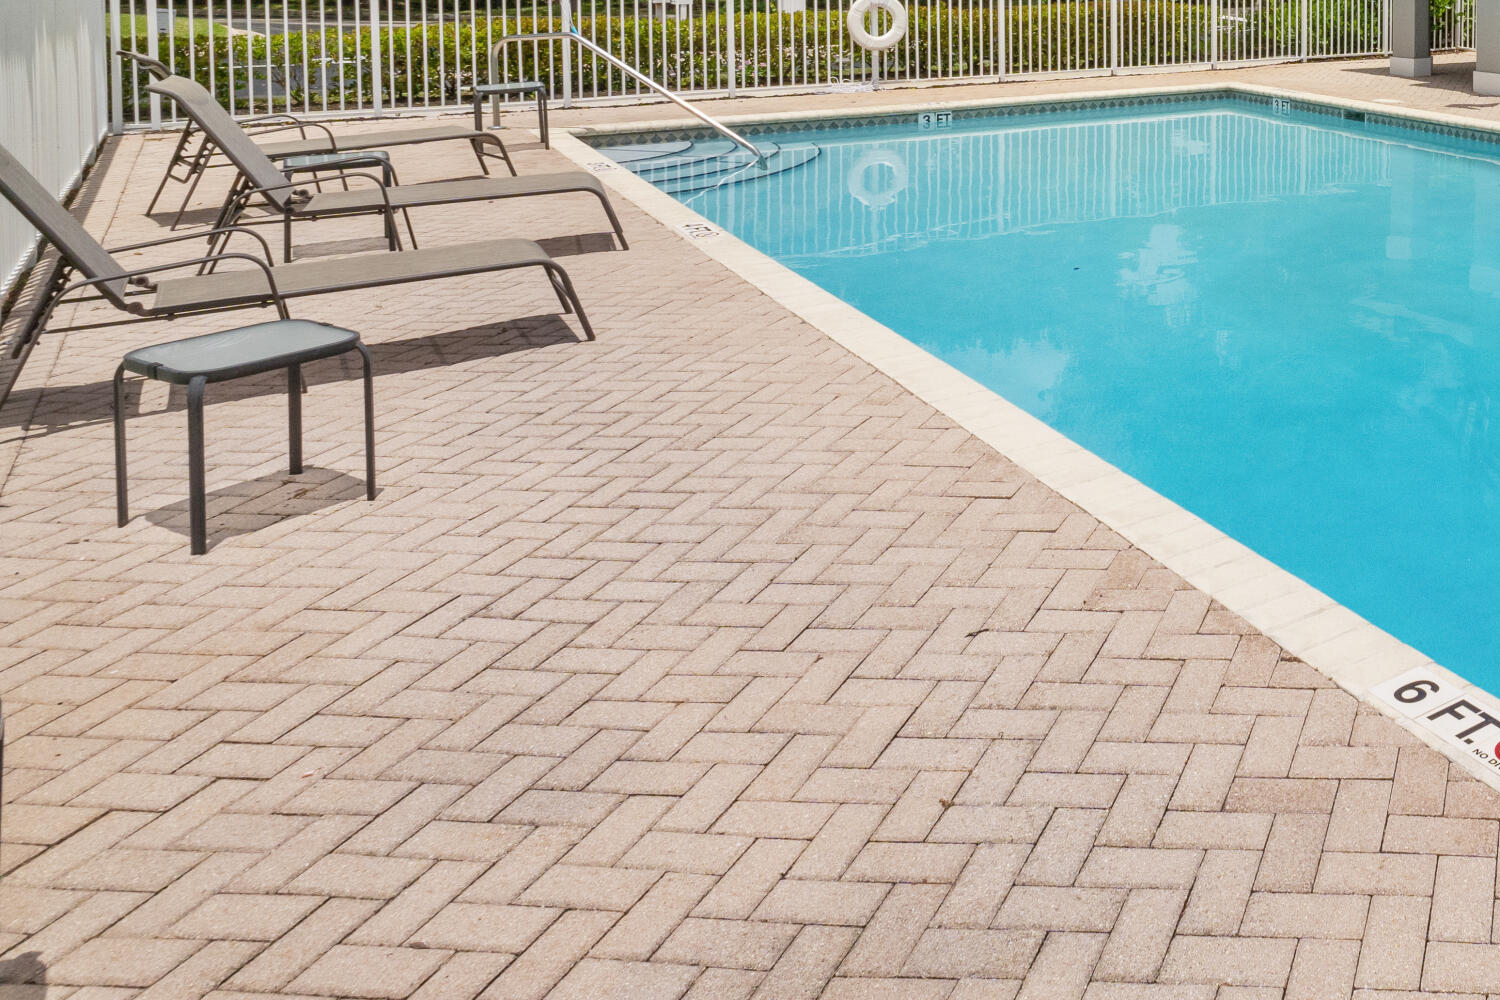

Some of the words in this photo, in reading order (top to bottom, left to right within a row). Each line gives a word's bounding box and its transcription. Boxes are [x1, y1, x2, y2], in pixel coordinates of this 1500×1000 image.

[923, 114, 931, 122] 3
[937, 113, 951, 123] FT
[1393, 679, 1440, 704] 6
[1472, 748, 1488, 760] NO
